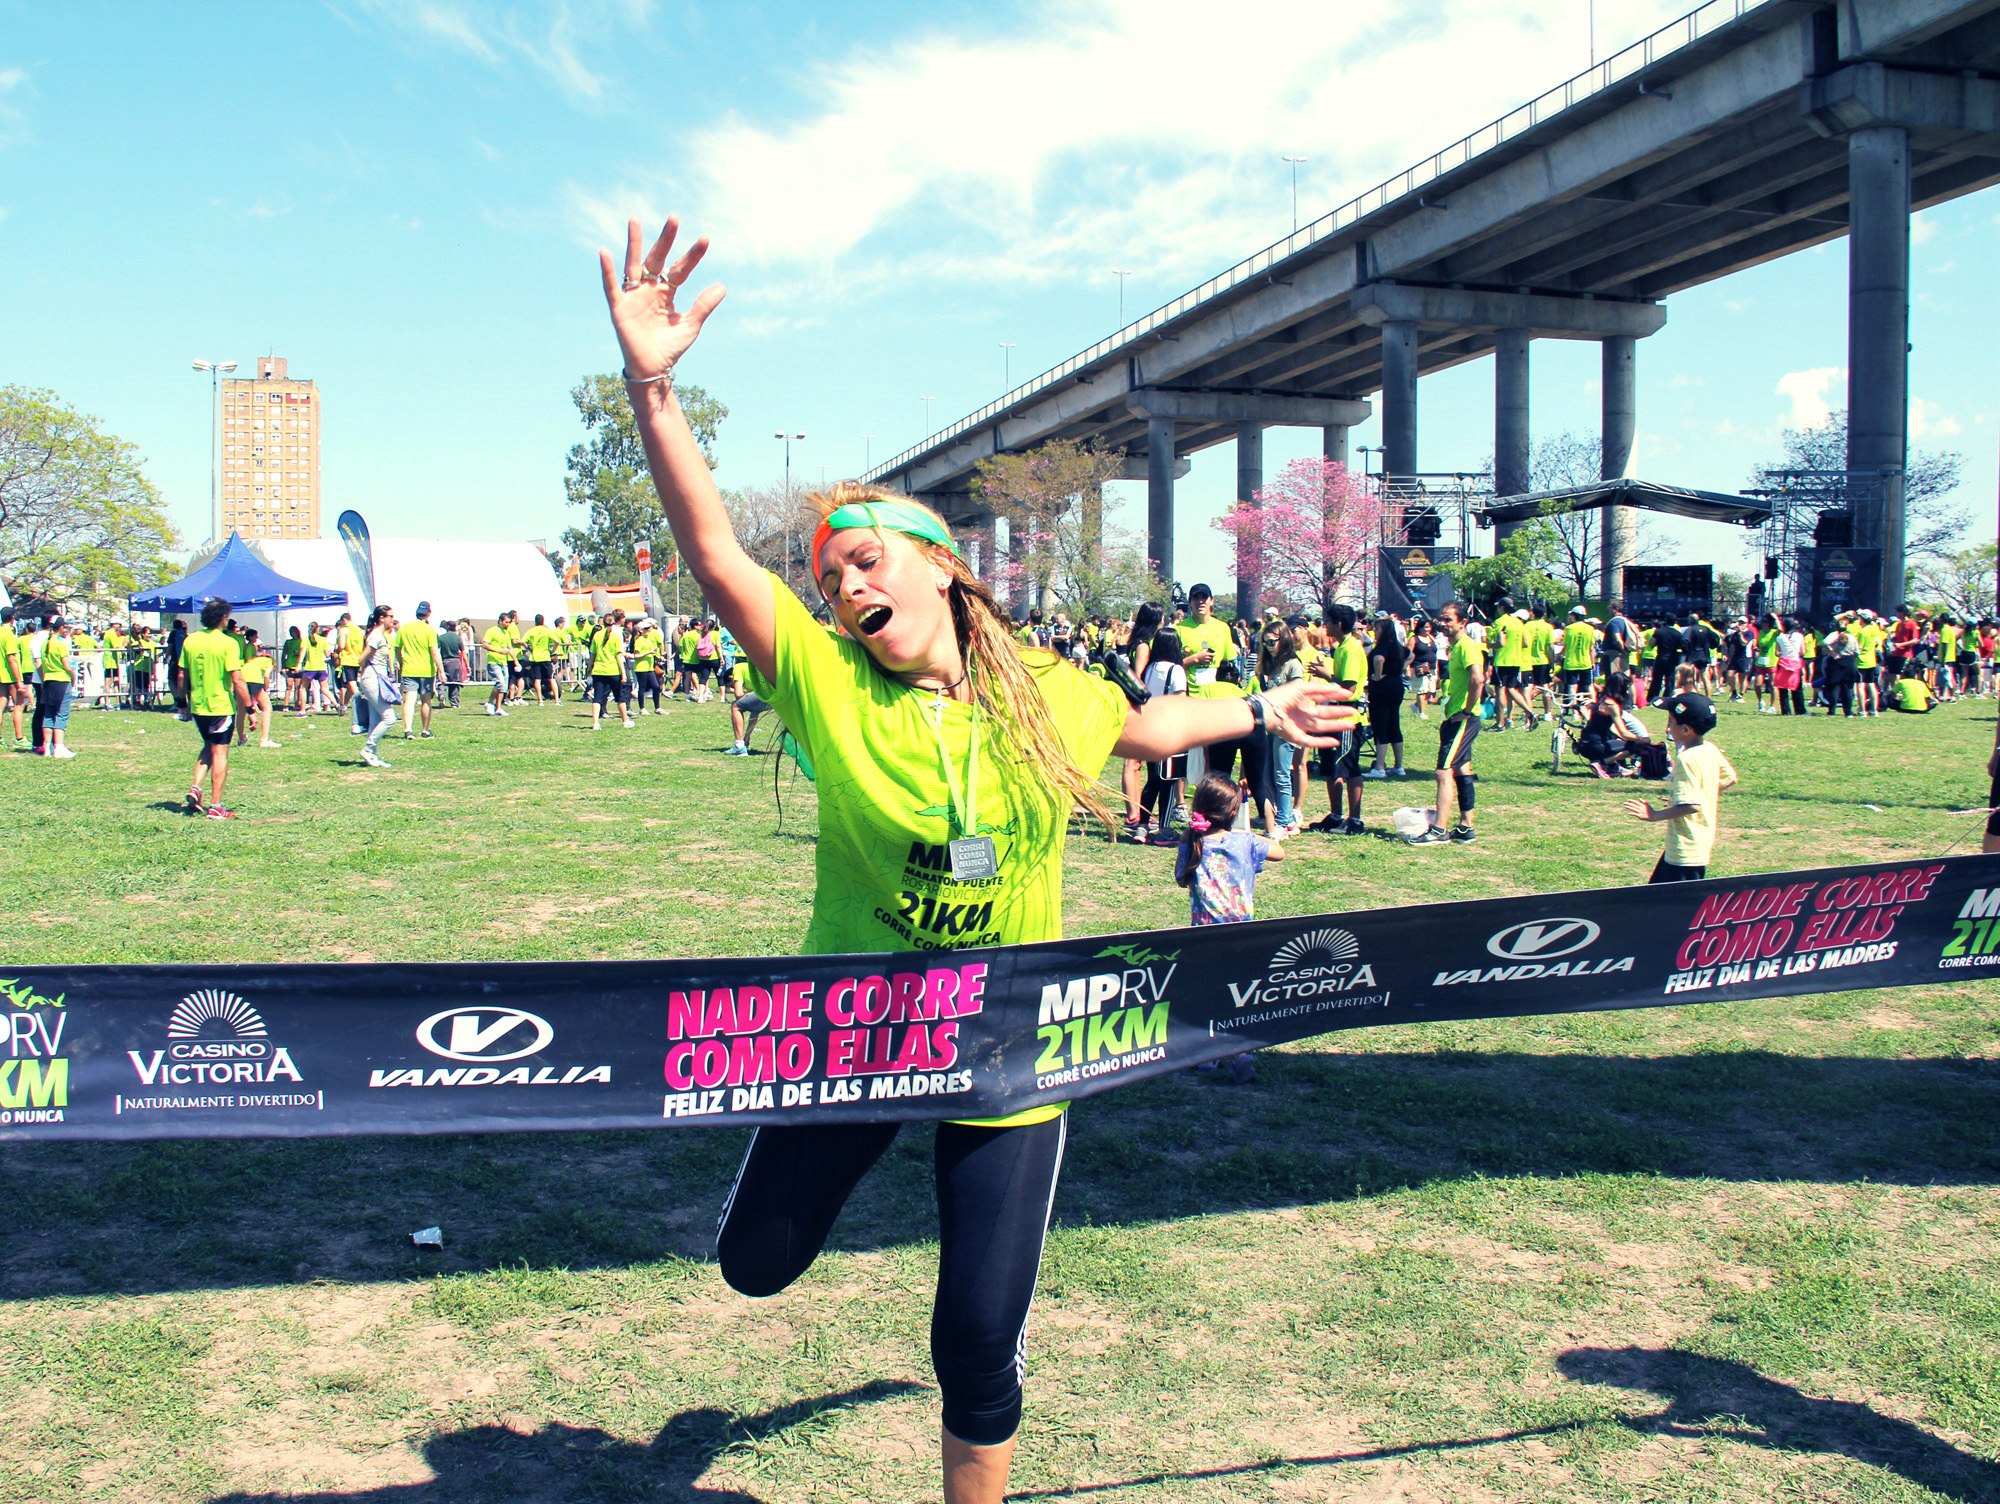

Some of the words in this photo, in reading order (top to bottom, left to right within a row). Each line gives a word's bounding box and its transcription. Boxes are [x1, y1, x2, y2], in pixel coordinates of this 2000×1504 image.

[901, 874, 951, 899] ROSARIO
[1688, 881, 1819, 930] NADIE
[1813, 864, 1946, 912] CORRE
[1675, 918, 1796, 971] COMO
[1794, 905, 1905, 954] ELLAS
[1268, 963, 1353, 984] CASINO
[1431, 956, 1636, 987] VANDALIA
[1663, 967, 1713, 995] FELIZ
[1754, 957, 1781, 981] DE
[1782, 951, 1818, 976] LAS
[1818, 940, 1900, 971] MADRES
[1938, 954, 1973, 969] CORRÉ
[666, 981, 815, 1041] NADIE
[824, 962, 989, 1025] CORRE
[1037, 962, 1178, 1026] MPRV
[1227, 964, 1378, 1009] VICTORIA
[1216, 1003, 1312, 1031] NATURALMENTE
[1316, 994, 1383, 1012] DIVERTIDO
[171, 1043, 266, 1059] CASINO
[663, 1033, 815, 1092] COMO
[826, 1022, 959, 1079] ELLAS
[1034, 1001, 1171, 1075] 21KM
[127, 1047, 304, 1085] VICTORIA
[369, 1064, 612, 1088] VANDALIA
[1036, 1066, 1080, 1090] CORRÉ
[1081, 1057, 1121, 1079] COMO
[1122, 1046, 1166, 1069] NUNCA
[125, 1096, 235, 1110] NATURALMENTE
[238, 1093, 316, 1108] DIVERTIDO
[662, 1088, 725, 1118] FELIZ
[781, 1084, 813, 1107] DE
[819, 1078, 864, 1105] LAS
[868, 1068, 973, 1100] MADRES
[14, 1109, 65, 1124] NUNCA
